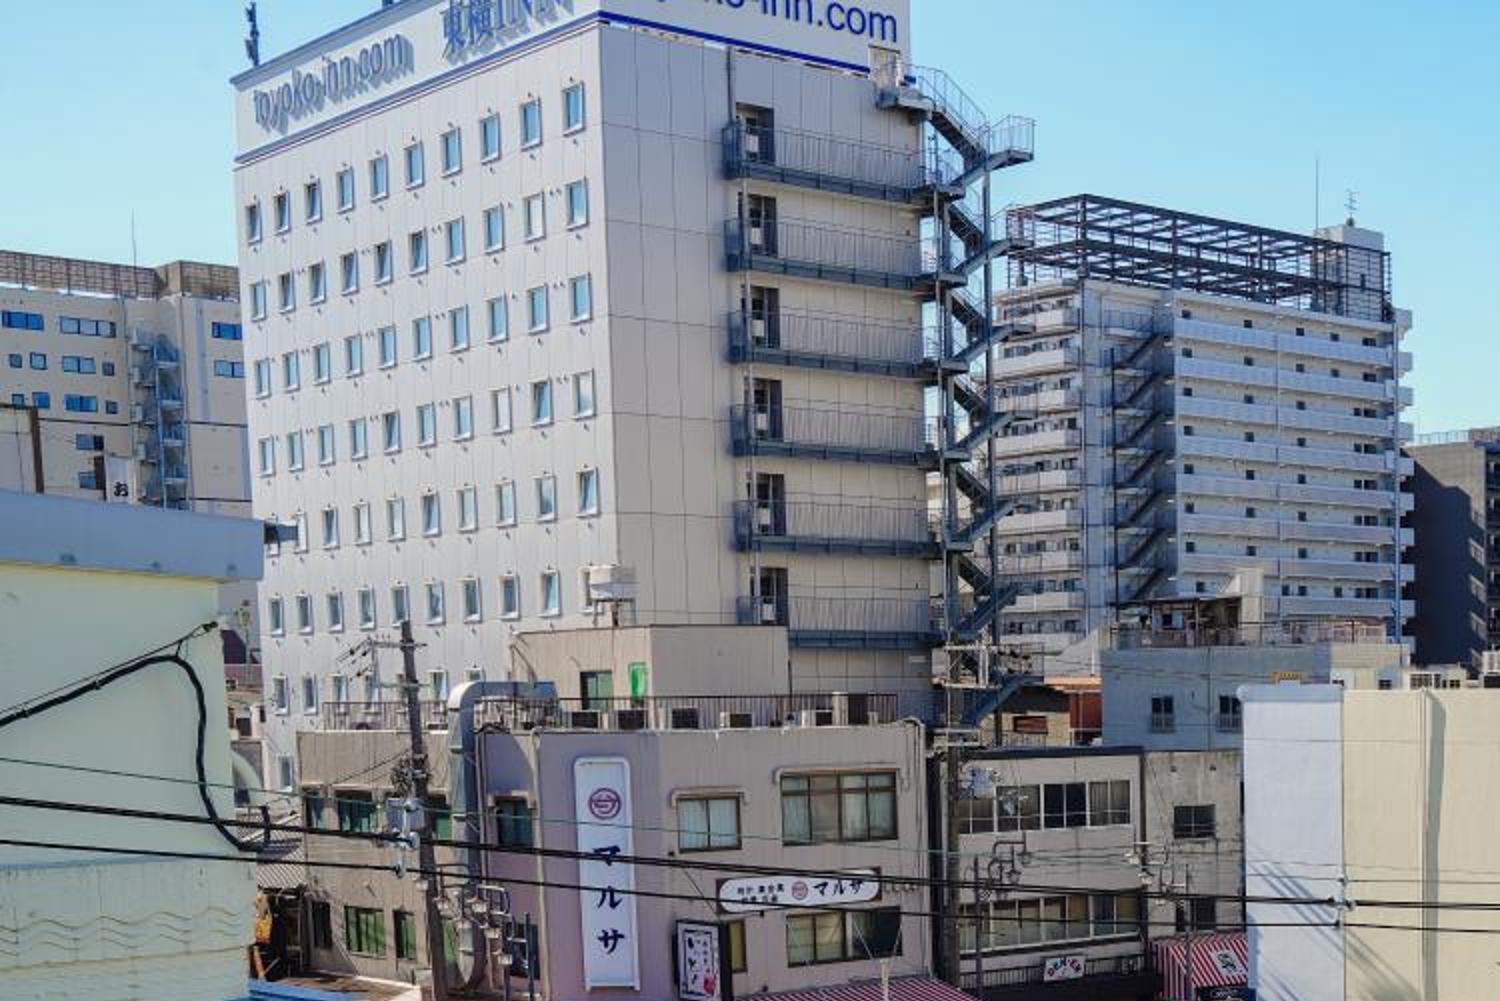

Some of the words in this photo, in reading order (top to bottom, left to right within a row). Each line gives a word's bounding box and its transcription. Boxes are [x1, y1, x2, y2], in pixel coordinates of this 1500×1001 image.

[253, 33, 414, 134] toyoko-inn.com
[592, 845, 625, 955] マルサ
[813, 879, 864, 897] マルサ
